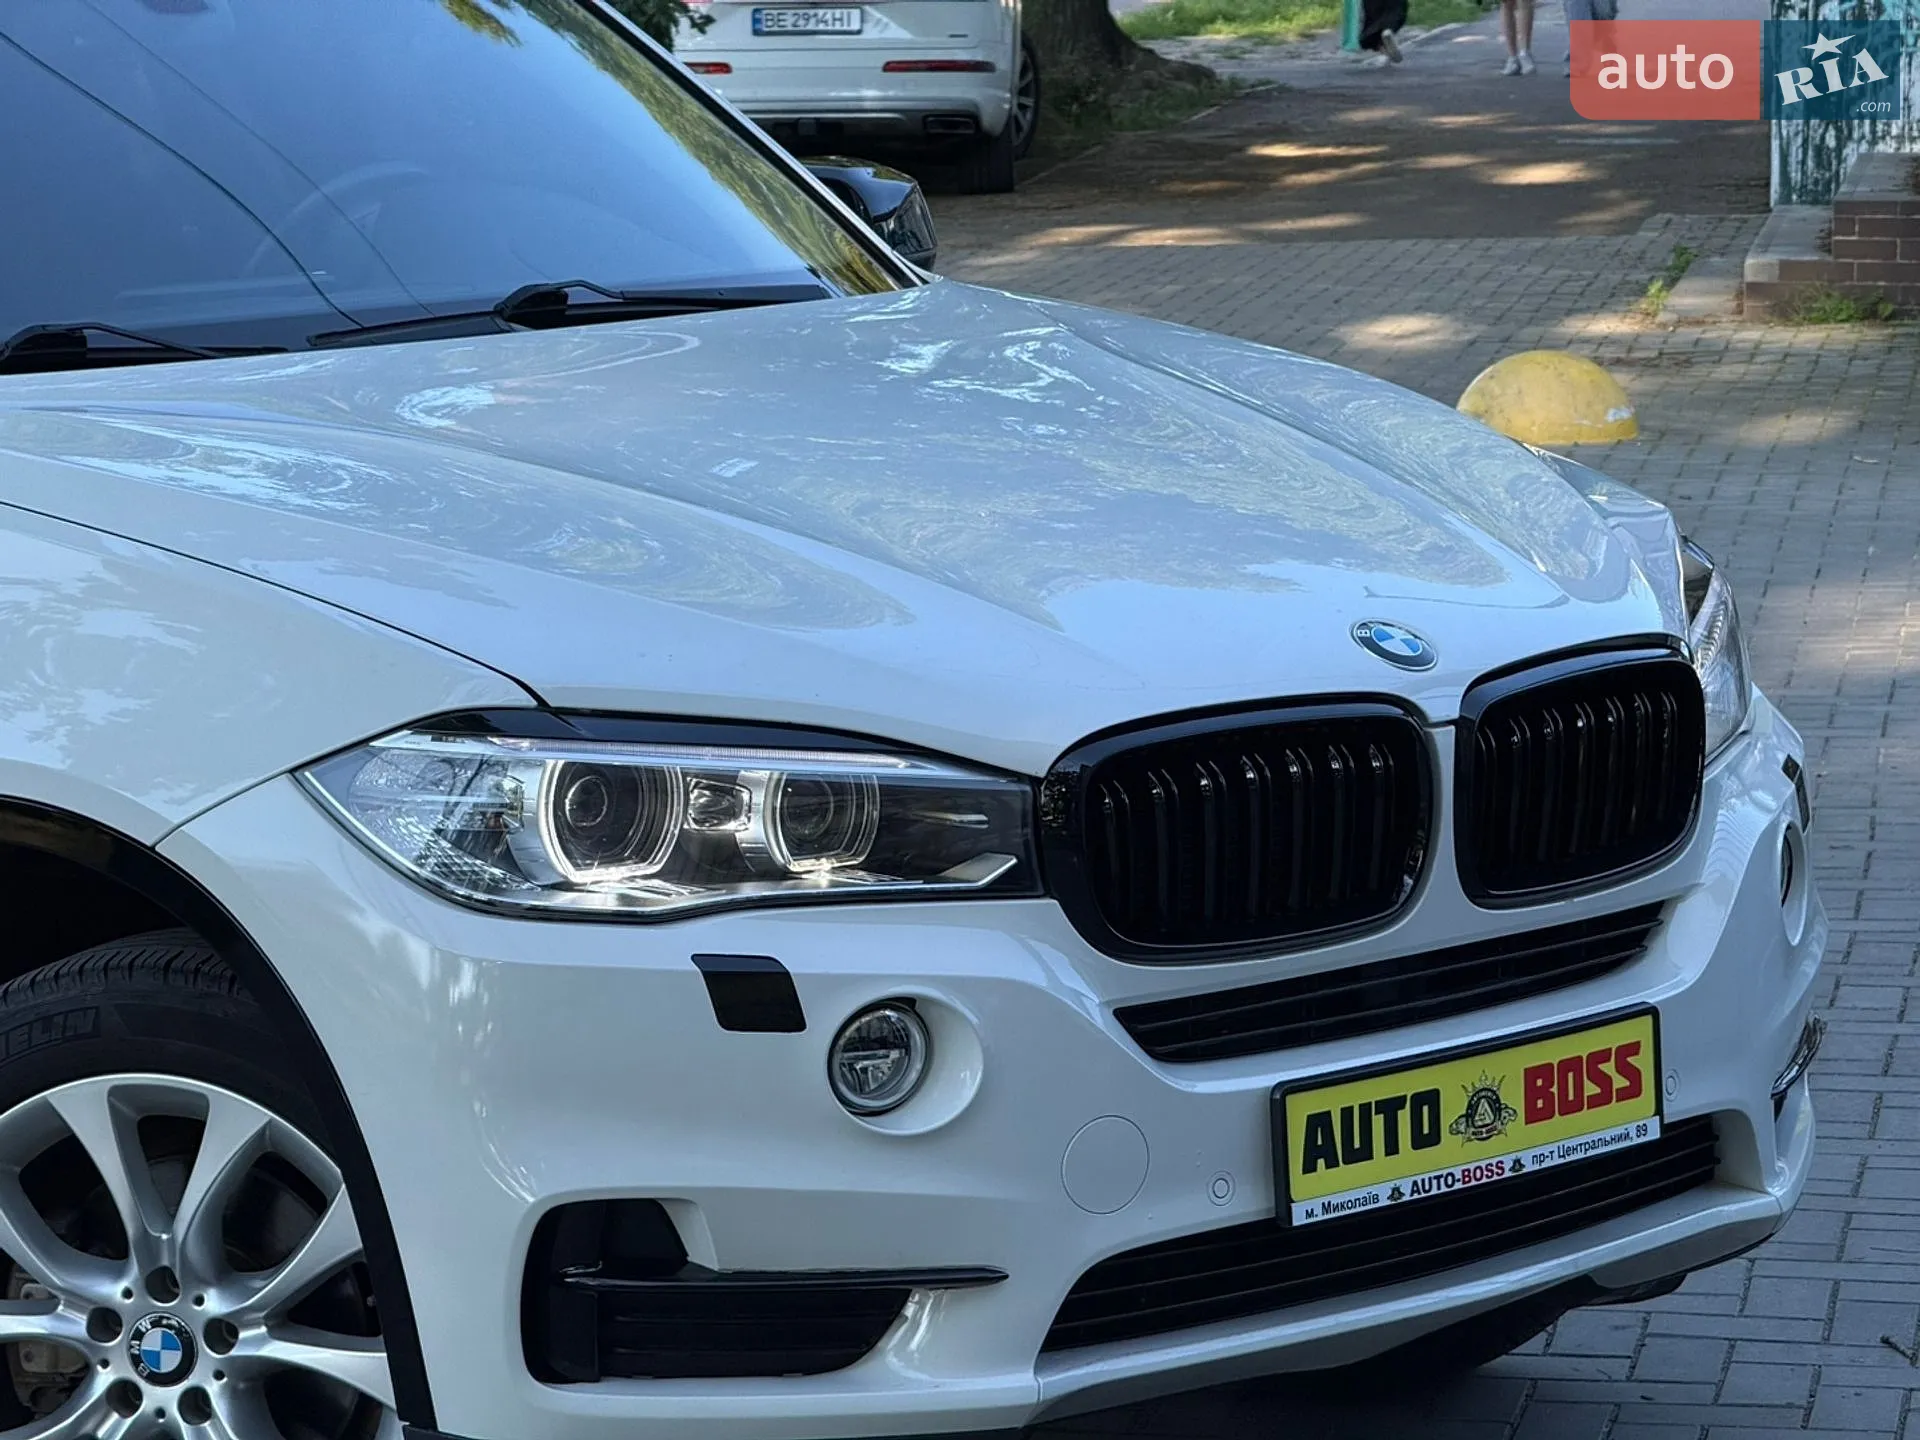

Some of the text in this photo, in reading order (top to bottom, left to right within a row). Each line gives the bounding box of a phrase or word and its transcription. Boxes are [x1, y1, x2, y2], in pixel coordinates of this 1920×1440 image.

[0, 1008, 95, 1058] ELIN
[1301, 1040, 1643, 1175] AUTO BOSS
[1321, 1192, 1380, 1216] Миколаїв
[1409, 1160, 1505, 1198] AUTO-BOSS
[1635, 1123, 1648, 1138] 89
